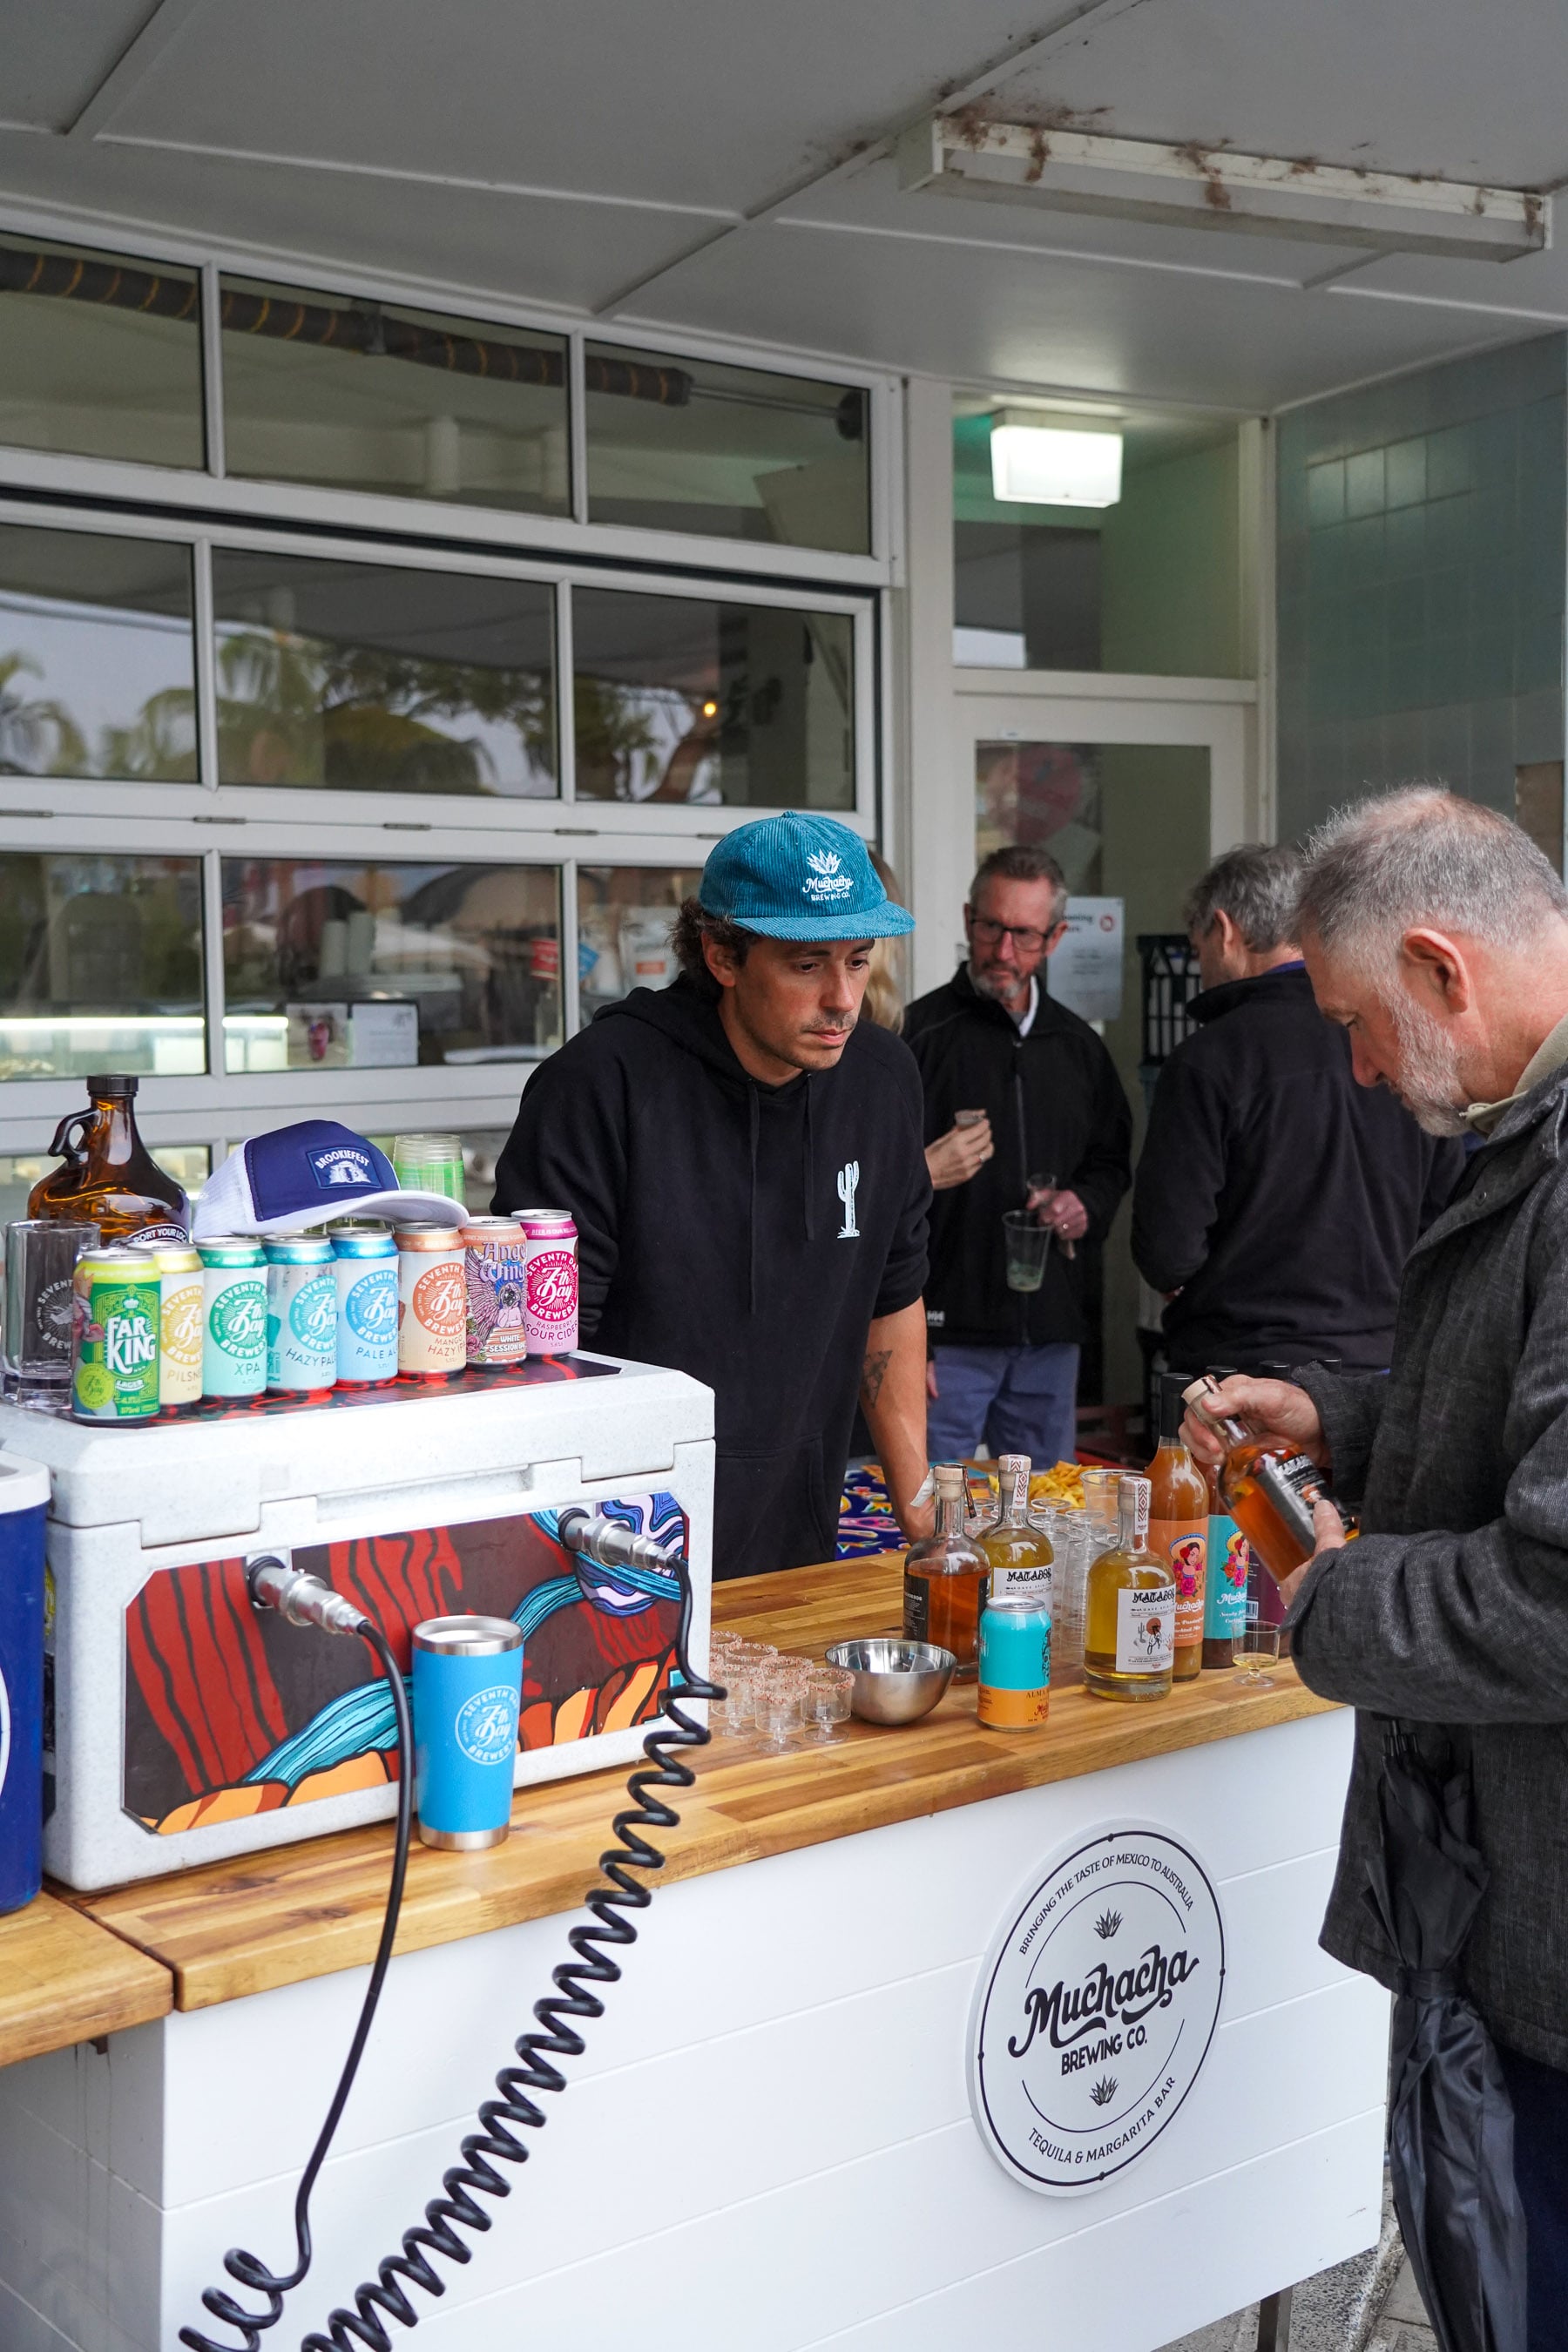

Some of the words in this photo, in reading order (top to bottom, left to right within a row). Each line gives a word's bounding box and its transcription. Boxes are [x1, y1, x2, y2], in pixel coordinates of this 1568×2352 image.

[802, 875, 854, 893] Muchacha
[314, 1149, 369, 1169] BROOKIEFEST
[133, 1230, 156, 1242] PORT
[157, 1228, 176, 1237] YOUR
[176, 1230, 187, 1242] LOC
[478, 1241, 526, 1263] Ange
[479, 1263, 524, 1283] Wing
[527, 1254, 567, 1276] SEVENTH
[418, 1266, 460, 1290] SEVENTH
[37, 1279, 73, 1304] SEVENT
[216, 1282, 260, 1309] SEVENTH
[536, 1282, 572, 1306] Day
[430, 1295, 463, 1321] Day
[531, 1300, 576, 1320] BREWERY
[107, 1316, 148, 1341] FAR
[500, 1335, 521, 1343] WHITE
[526, 1323, 555, 1341] SOUR
[43, 1331, 72, 1350] BREW
[428, 1345, 455, 1357] HAZY
[489, 1343, 517, 1353] SESSION
[107, 1332, 156, 1375] KING
[286, 1348, 319, 1366] HAZY
[356, 1347, 384, 1359] PALE
[234, 1362, 260, 1375] XPA
[463, 1690, 509, 1717] SEVENTH
[475, 1721, 511, 1747] Day
[1019, 1898, 1058, 1956] BRINGING
[1055, 1880, 1074, 1900] THE
[1074, 1864, 1101, 1884] TASTE
[1102, 1855, 1115, 1869] OF
[1116, 1853, 1150, 1867] MEXICO
[1151, 1857, 1162, 1872] TO
[1160, 1865, 1195, 1911] AUSTRALIA
[1007, 1943, 1200, 2058] Muchacha
[1061, 2032, 1123, 2076] BREWING
[1126, 2024, 1148, 2051] CO.
[1028, 2127, 1072, 2164] TEQUILA
[1075, 2151, 1084, 2164] &
[1085, 2109, 1155, 2164] MARGARITA
[1154, 2076, 1176, 2108] BAR
